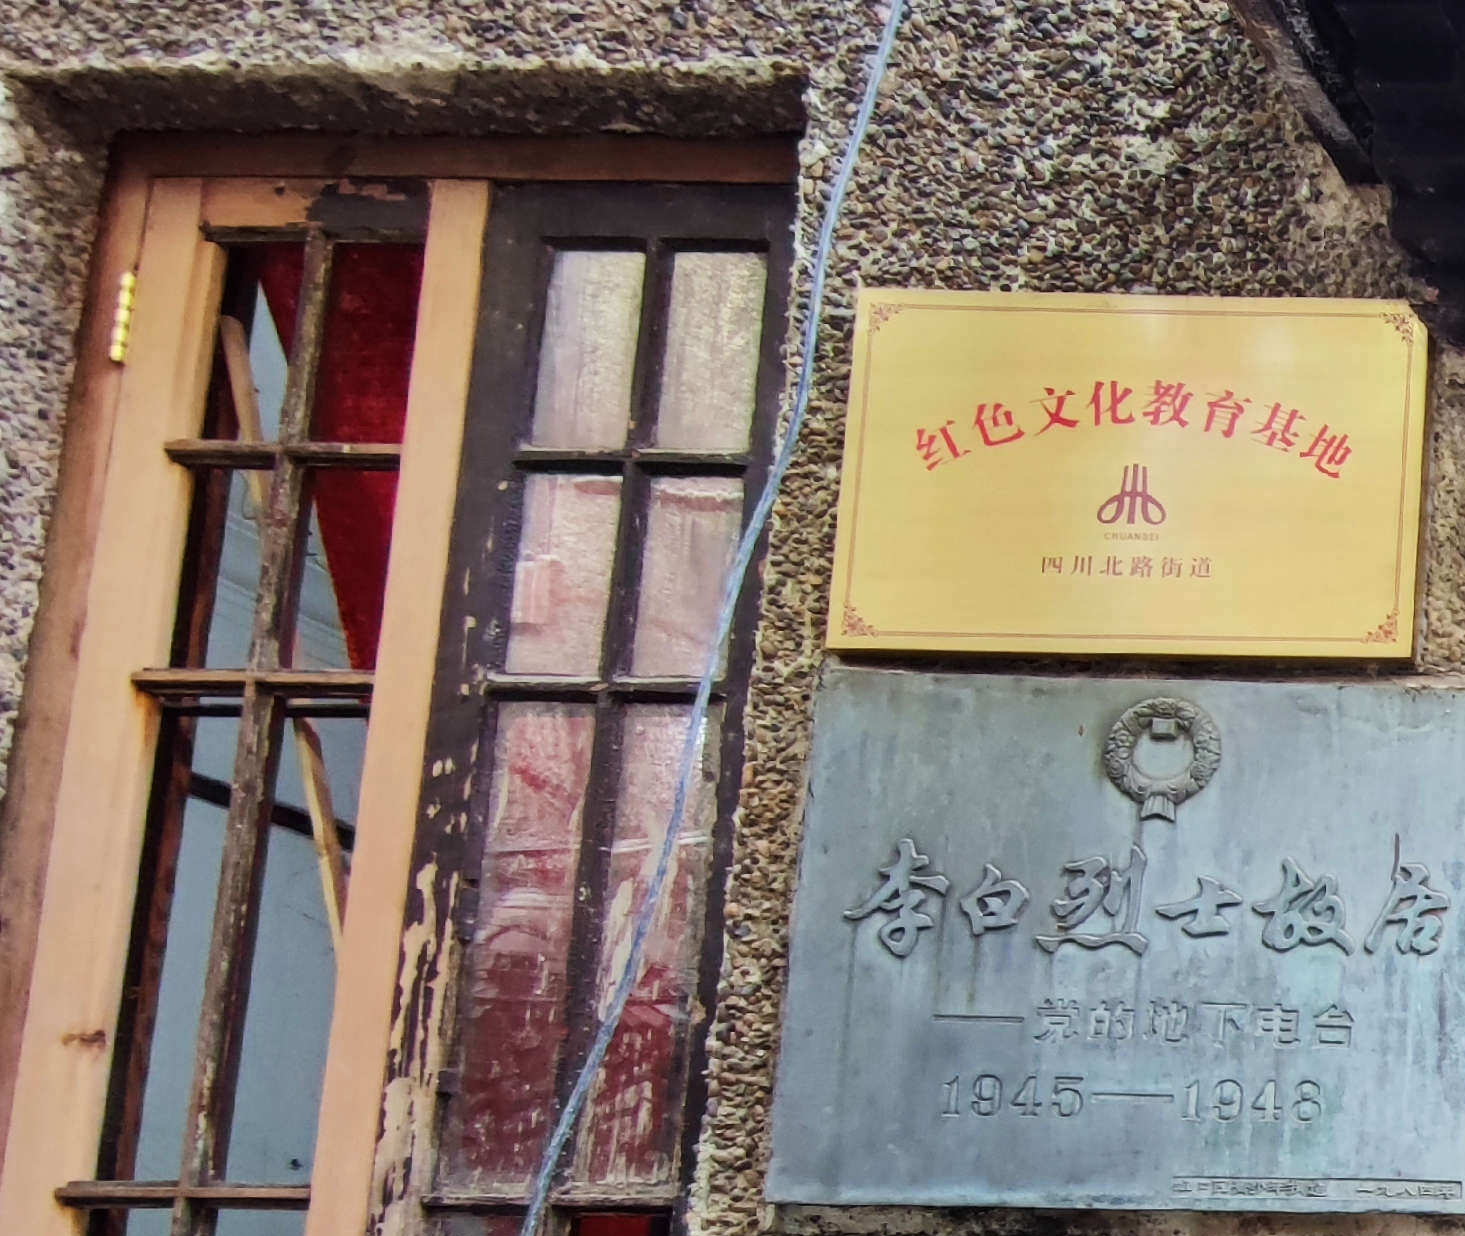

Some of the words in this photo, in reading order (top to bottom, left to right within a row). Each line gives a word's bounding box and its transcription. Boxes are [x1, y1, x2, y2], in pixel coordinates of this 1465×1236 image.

[914, 380, 1353, 479] 红色文化教育基地
[1041, 555, 1212, 578] 四川北路街道
[844, 833, 1451, 958] 李白烈士故居
